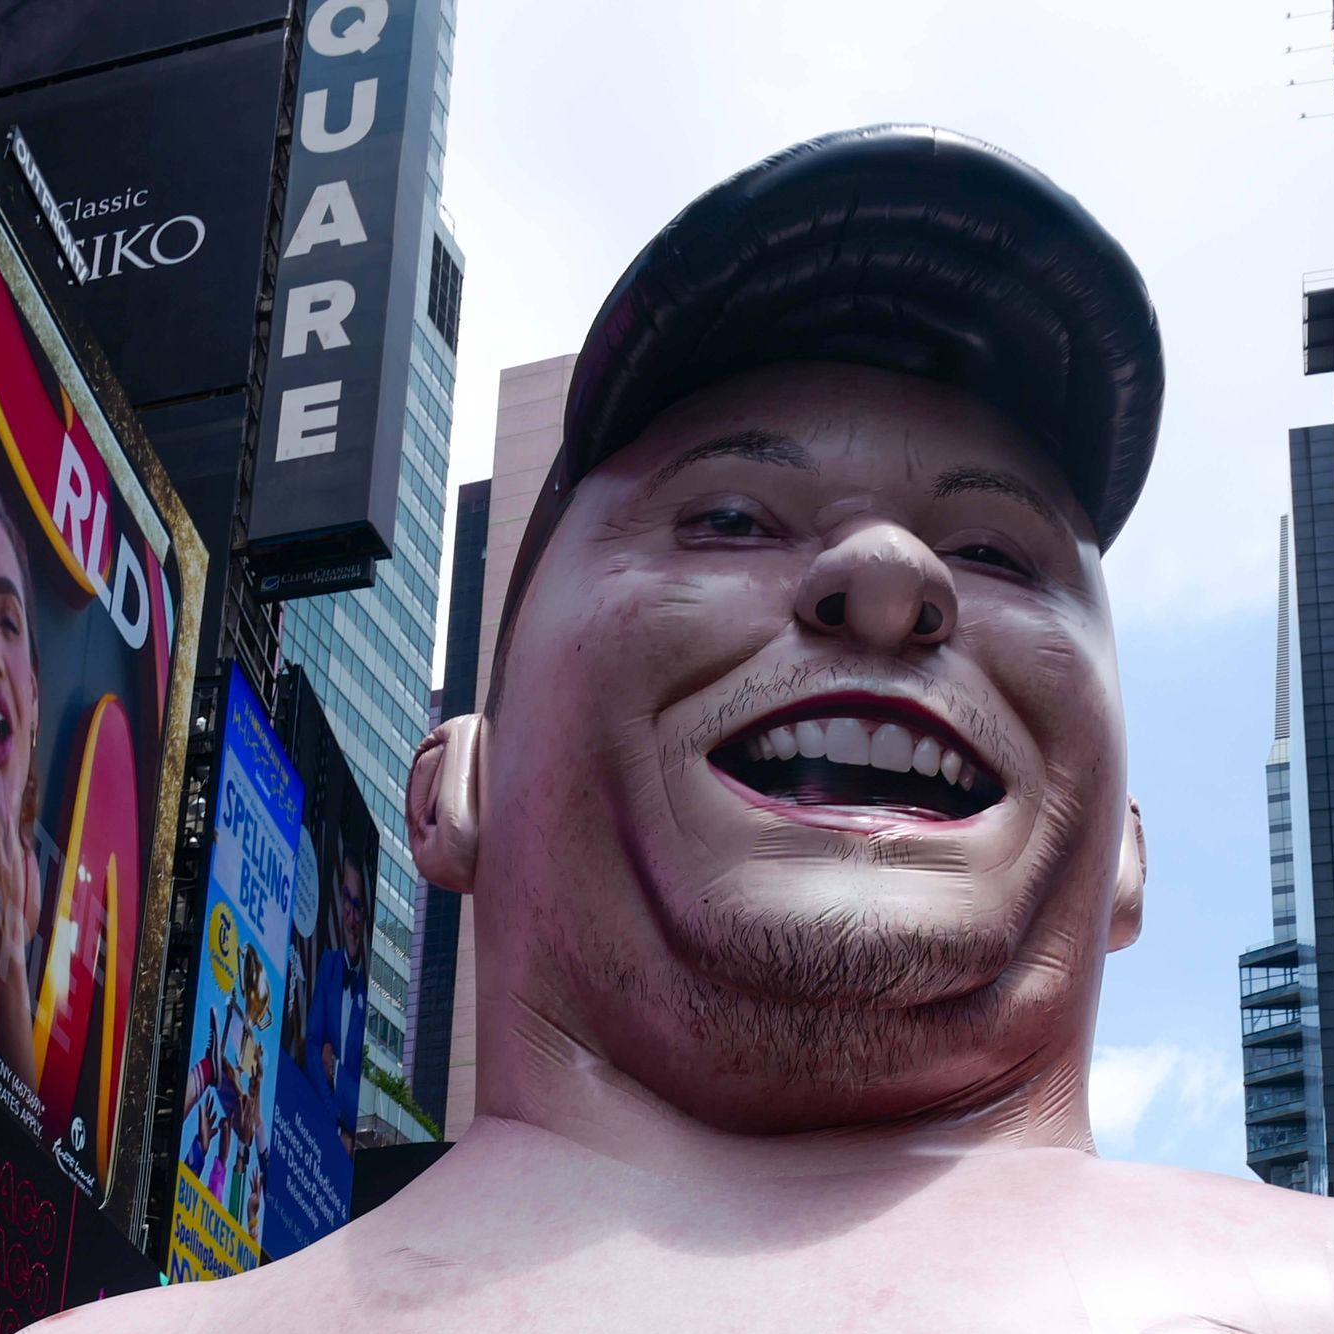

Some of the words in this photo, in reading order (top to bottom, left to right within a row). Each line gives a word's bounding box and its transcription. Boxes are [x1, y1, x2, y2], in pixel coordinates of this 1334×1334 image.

[75, 214, 206, 282] IKO
[223, 780, 291, 914] SPELLING
[240, 857, 268, 936] BEE
[19, 1108, 44, 1140] APPLY.
[272, 1128, 287, 1160] The
[274, 1103, 304, 1159] Business
[177, 1177, 200, 1217] BUY
[200, 1197, 237, 1258] TICKETS
